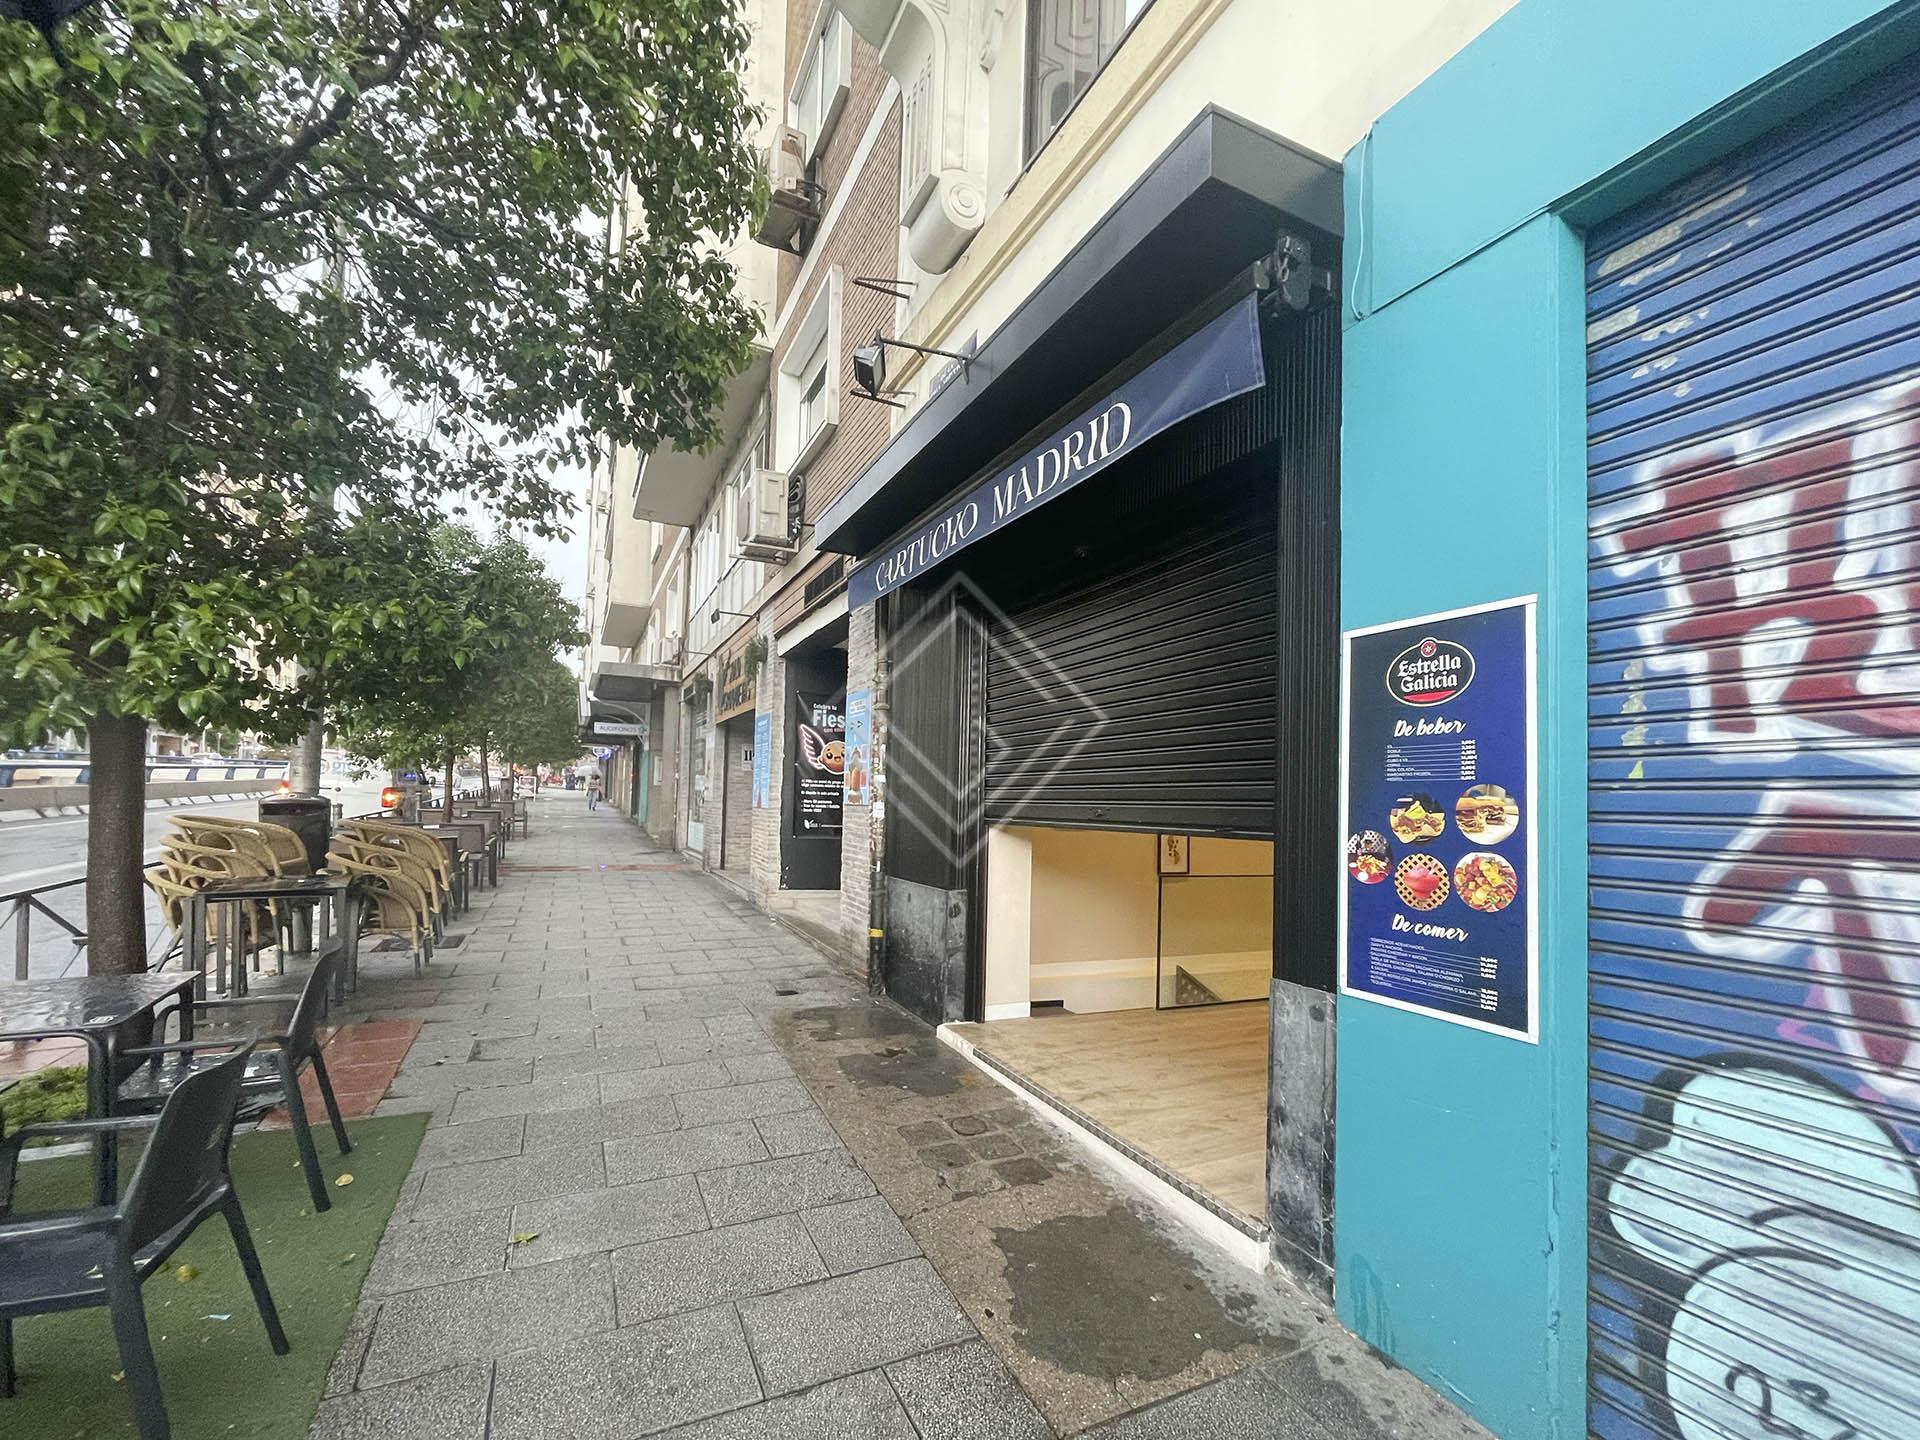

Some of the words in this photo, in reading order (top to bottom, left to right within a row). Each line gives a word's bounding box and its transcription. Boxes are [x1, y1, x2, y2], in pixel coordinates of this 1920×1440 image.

[992, 402, 1132, 524] MADRID
[1397, 654, 1461, 677] Estrella
[1401, 671, 1458, 692] Galicia
[1394, 719, 1416, 737] De
[1416, 716, 1466, 736] beber
[1392, 913, 1414, 932] De
[1414, 922, 1469, 942] comer
